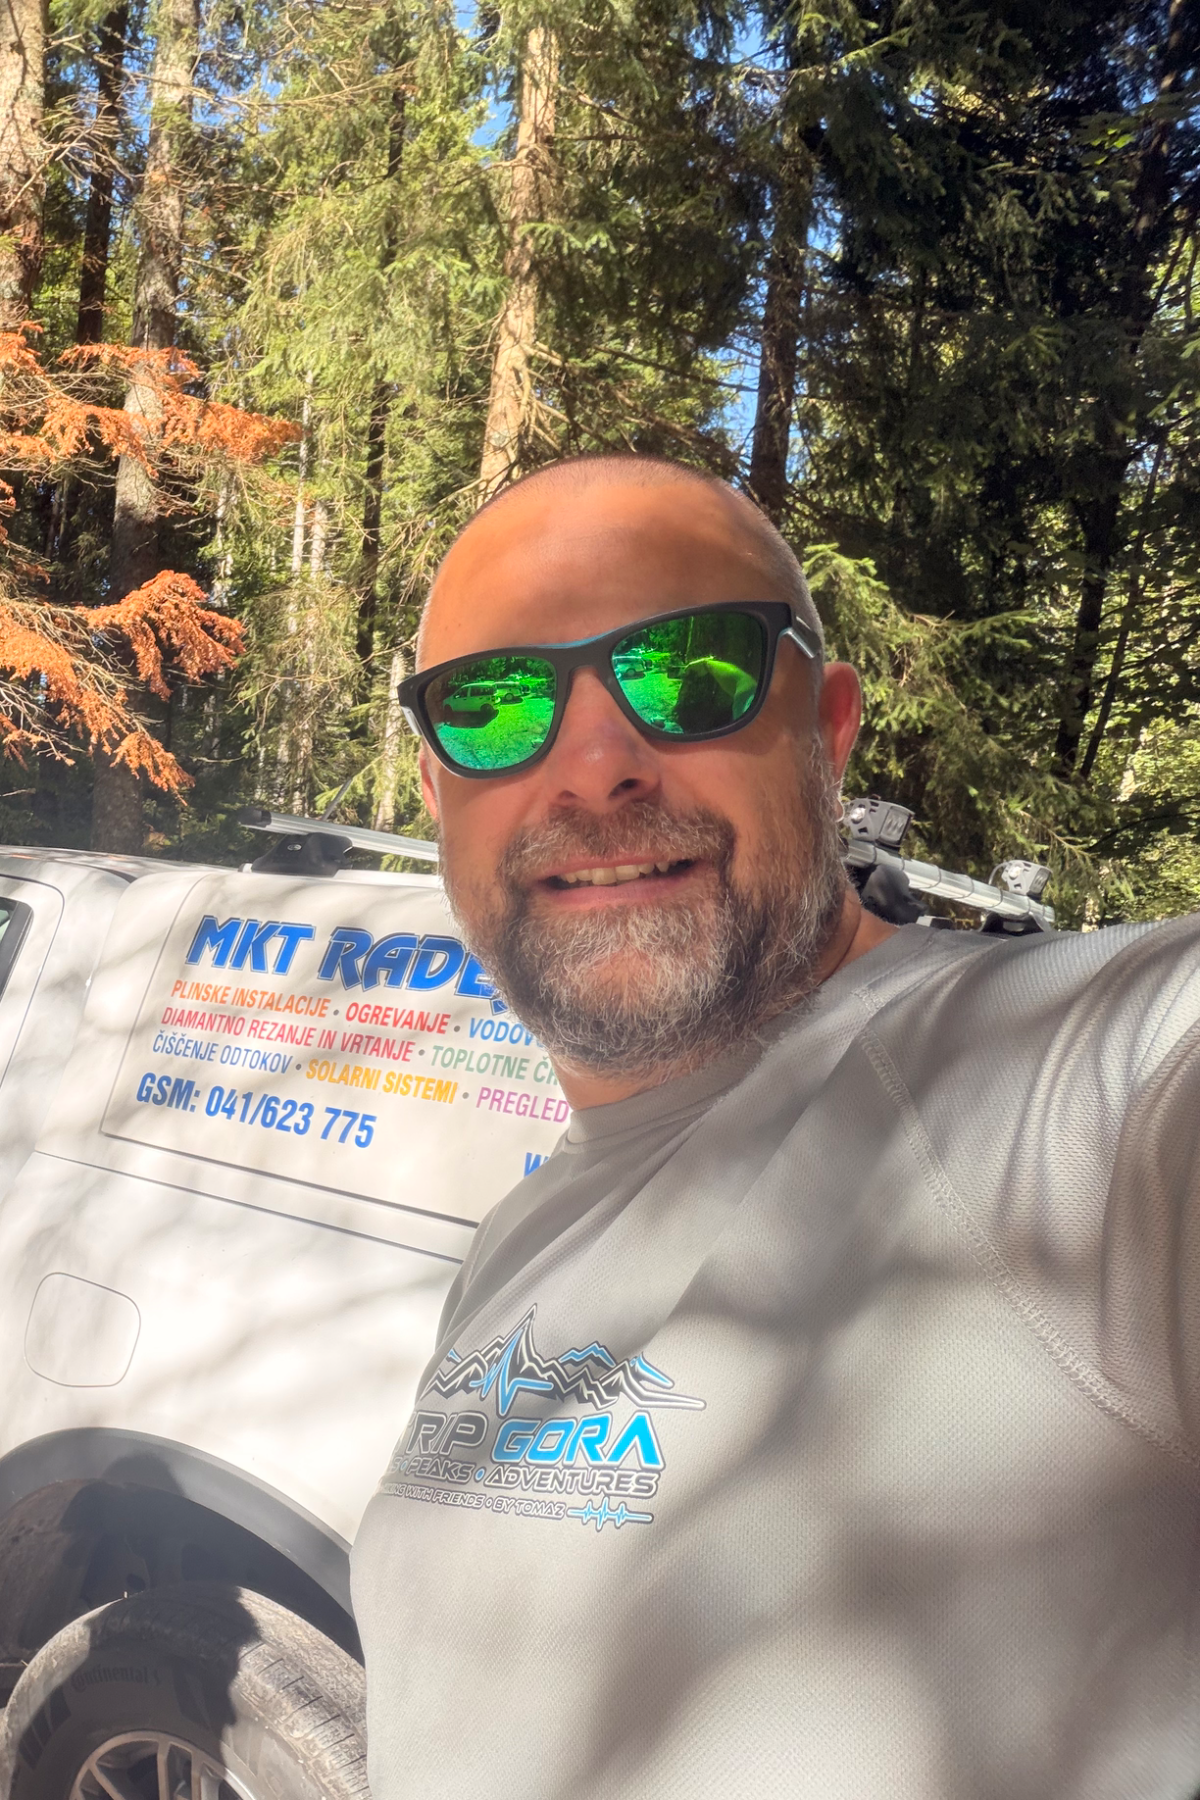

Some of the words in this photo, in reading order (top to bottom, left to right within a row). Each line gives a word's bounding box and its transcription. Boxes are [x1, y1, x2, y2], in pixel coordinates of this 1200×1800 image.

[185, 915, 316, 976] MKT
[317, 926, 508, 1016] RADE
[161, 1007, 246, 1036] DIAMANTNO
[247, 1019, 315, 1047] REZANJE
[317, 1030, 337, 1049] IN
[339, 1033, 416, 1062] VRTANJE
[430, 1044, 530, 1081] TOPLOTNE
[170, 979, 231, 1006] PLINSKE
[232, 988, 331, 1018] INSTALACIJE
[345, 1002, 451, 1035] OGREVANJE
[469, 1018, 546, 1048] VODOV
[152, 1029, 219, 1063] ČIŠČENJE
[219, 1044, 294, 1074] ODTOKOV
[306, 1059, 380, 1091] SOLARNI
[382, 1070, 459, 1104] SISTEMI
[136, 1072, 201, 1113] GSM:
[205, 1085, 315, 1136] 041/623
[320, 1106, 378, 1149] 775
[404, 1410, 488, 1457] RIP
[491, 1411, 666, 1471] GORA
[404, 1455, 478, 1483] PEAKS
[483, 1465, 661, 1498] ADVENTURES
[406, 1484, 433, 1501] WITH
[433, 1489, 486, 1510] FRIENDS
[492, 1497, 515, 1513] BY
[515, 1499, 566, 1519] TOMAZ
